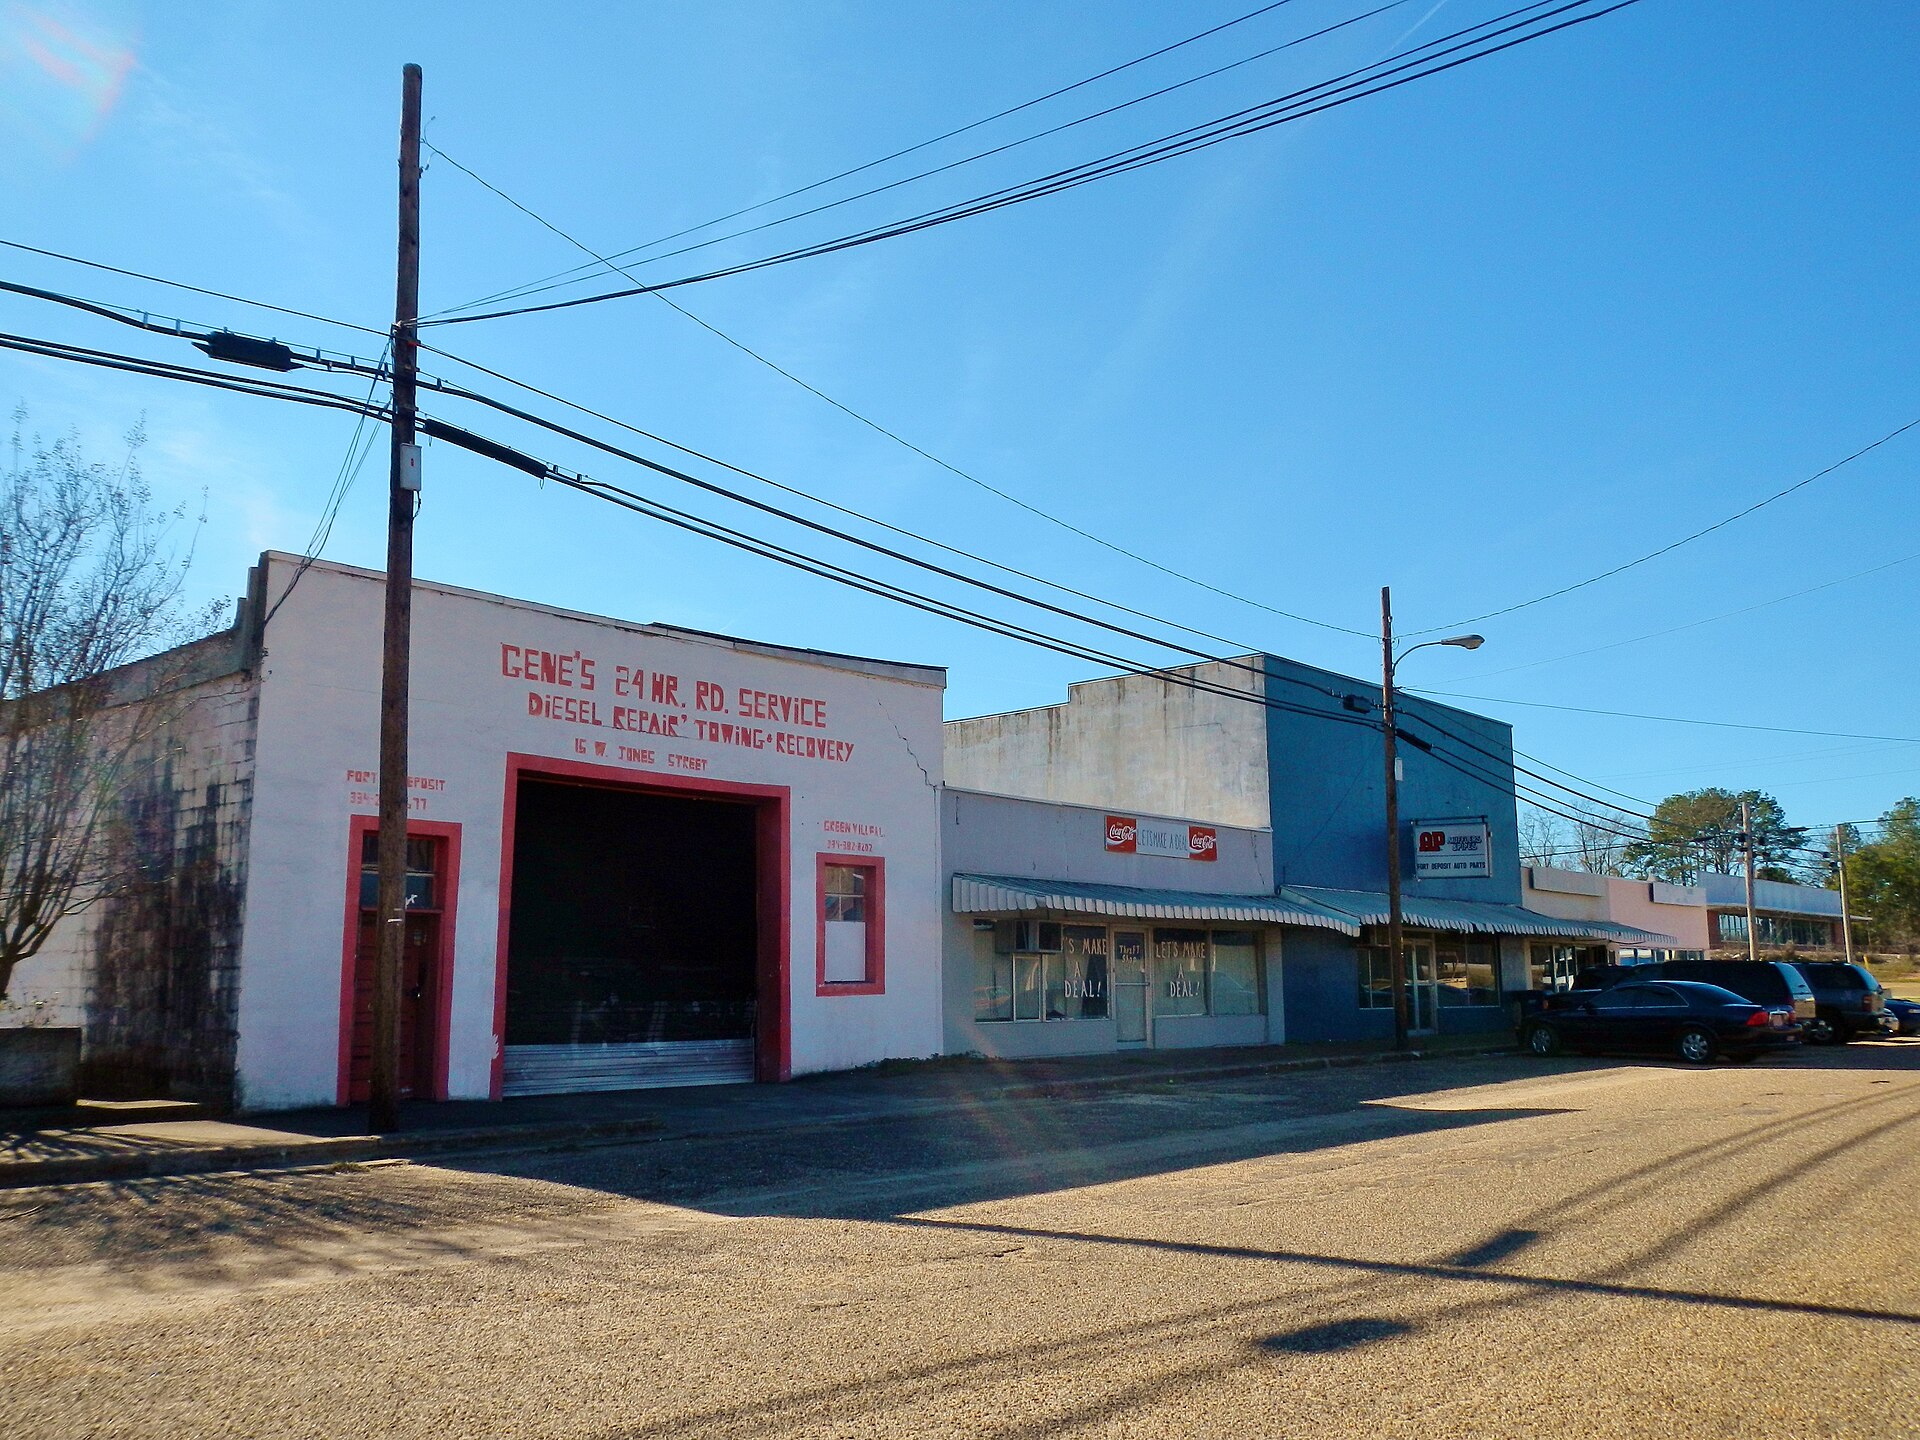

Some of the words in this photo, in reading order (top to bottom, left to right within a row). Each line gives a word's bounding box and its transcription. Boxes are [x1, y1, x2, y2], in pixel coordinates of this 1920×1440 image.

[502, 644, 595, 690] GENE'S
[615, 665, 645, 699] 24
[696, 681, 729, 714] RD.
[575, 738, 586, 754] 15
[618, 745, 655, 764] JONES
[668, 753, 707, 771] STREET
[406, 776, 446, 791] EPOSIT
[1431, 862, 1452, 870] DEPOSIT
[1469, 861, 1486, 869] PARTS
[1082, 938, 1107, 955] MAKE
[1156, 941, 1179, 958] LET'S
[1182, 942, 1206, 959] MAKE
[1074, 961, 1081, 977] A
[1178, 963, 1184, 979] A
[1064, 979, 1101, 998] DEAL!
[1170, 981, 1200, 998] DEAL!
